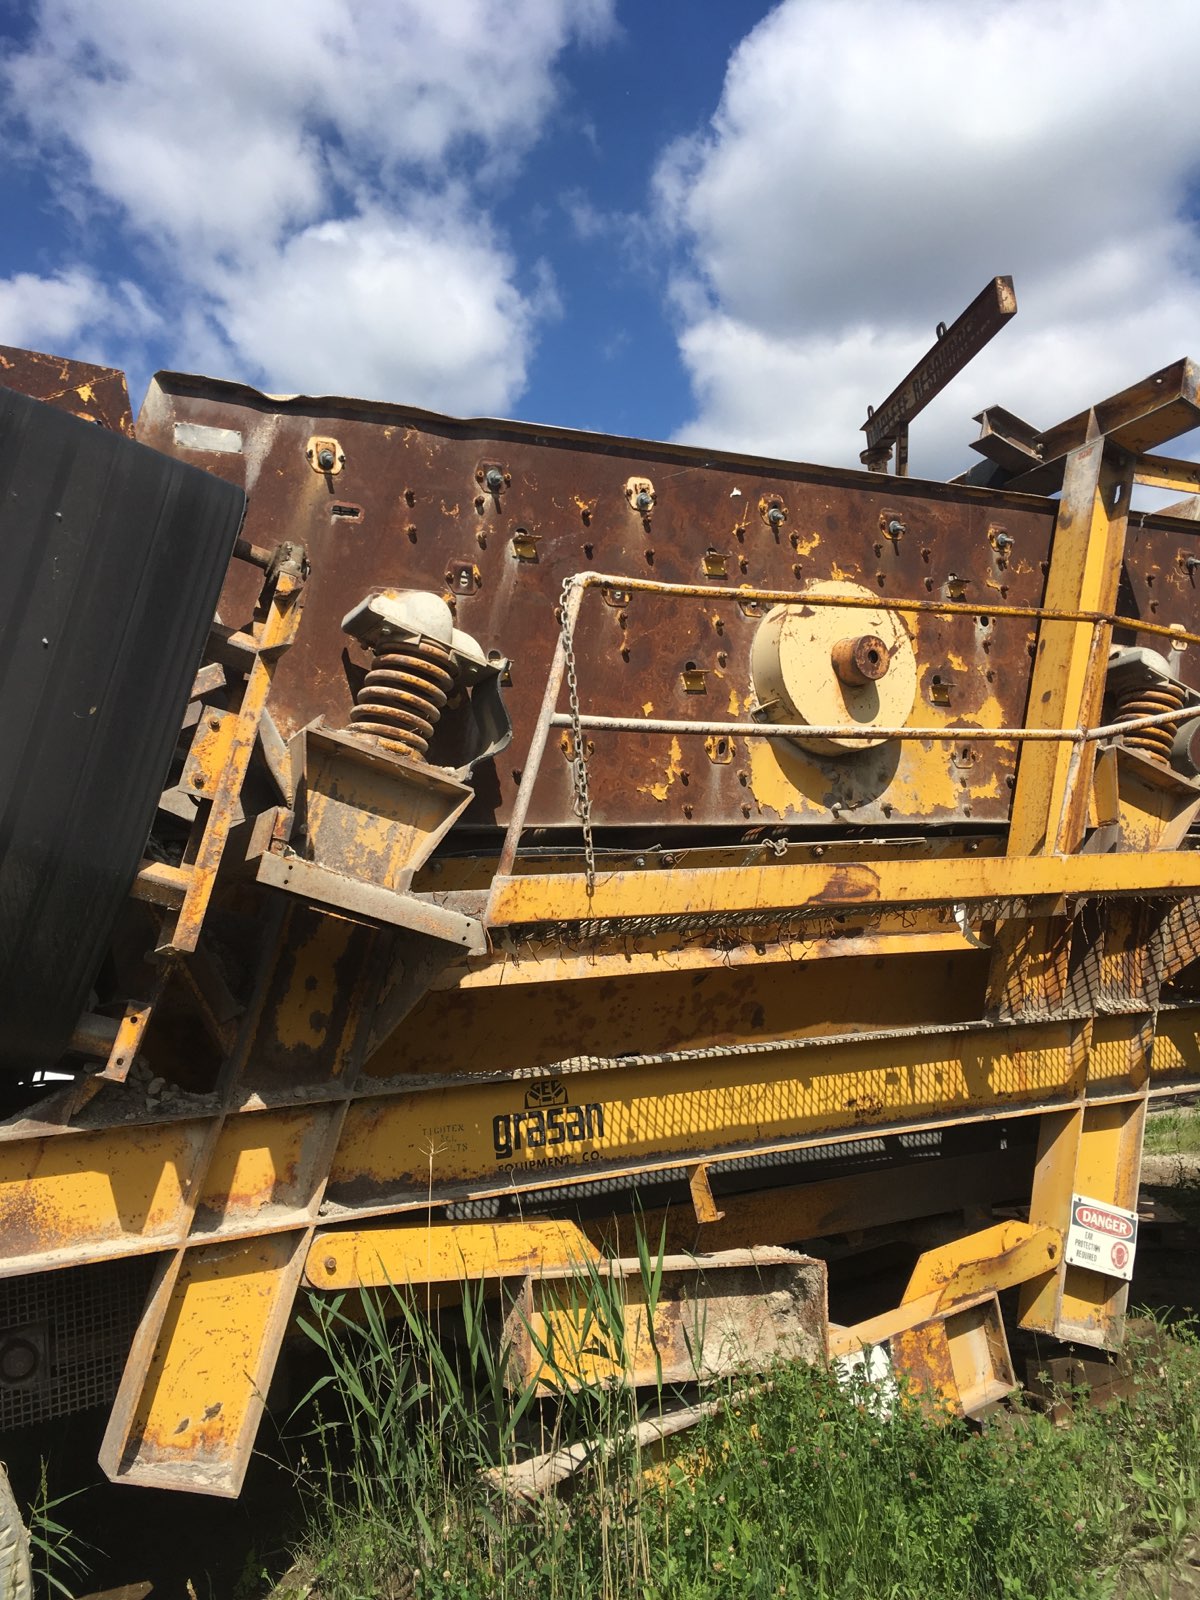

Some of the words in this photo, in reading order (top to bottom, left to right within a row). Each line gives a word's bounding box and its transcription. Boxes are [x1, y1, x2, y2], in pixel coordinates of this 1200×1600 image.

[492, 1102, 604, 1160] grasan
[498, 1154, 574, 1173] EQUIPMENT
[582, 1150, 604, 1162] CO.
[1082, 1210, 1127, 1235] DANGER
[1085, 1231, 1093, 1241] EAR
[1076, 1249, 1097, 1262] REQUIRED
